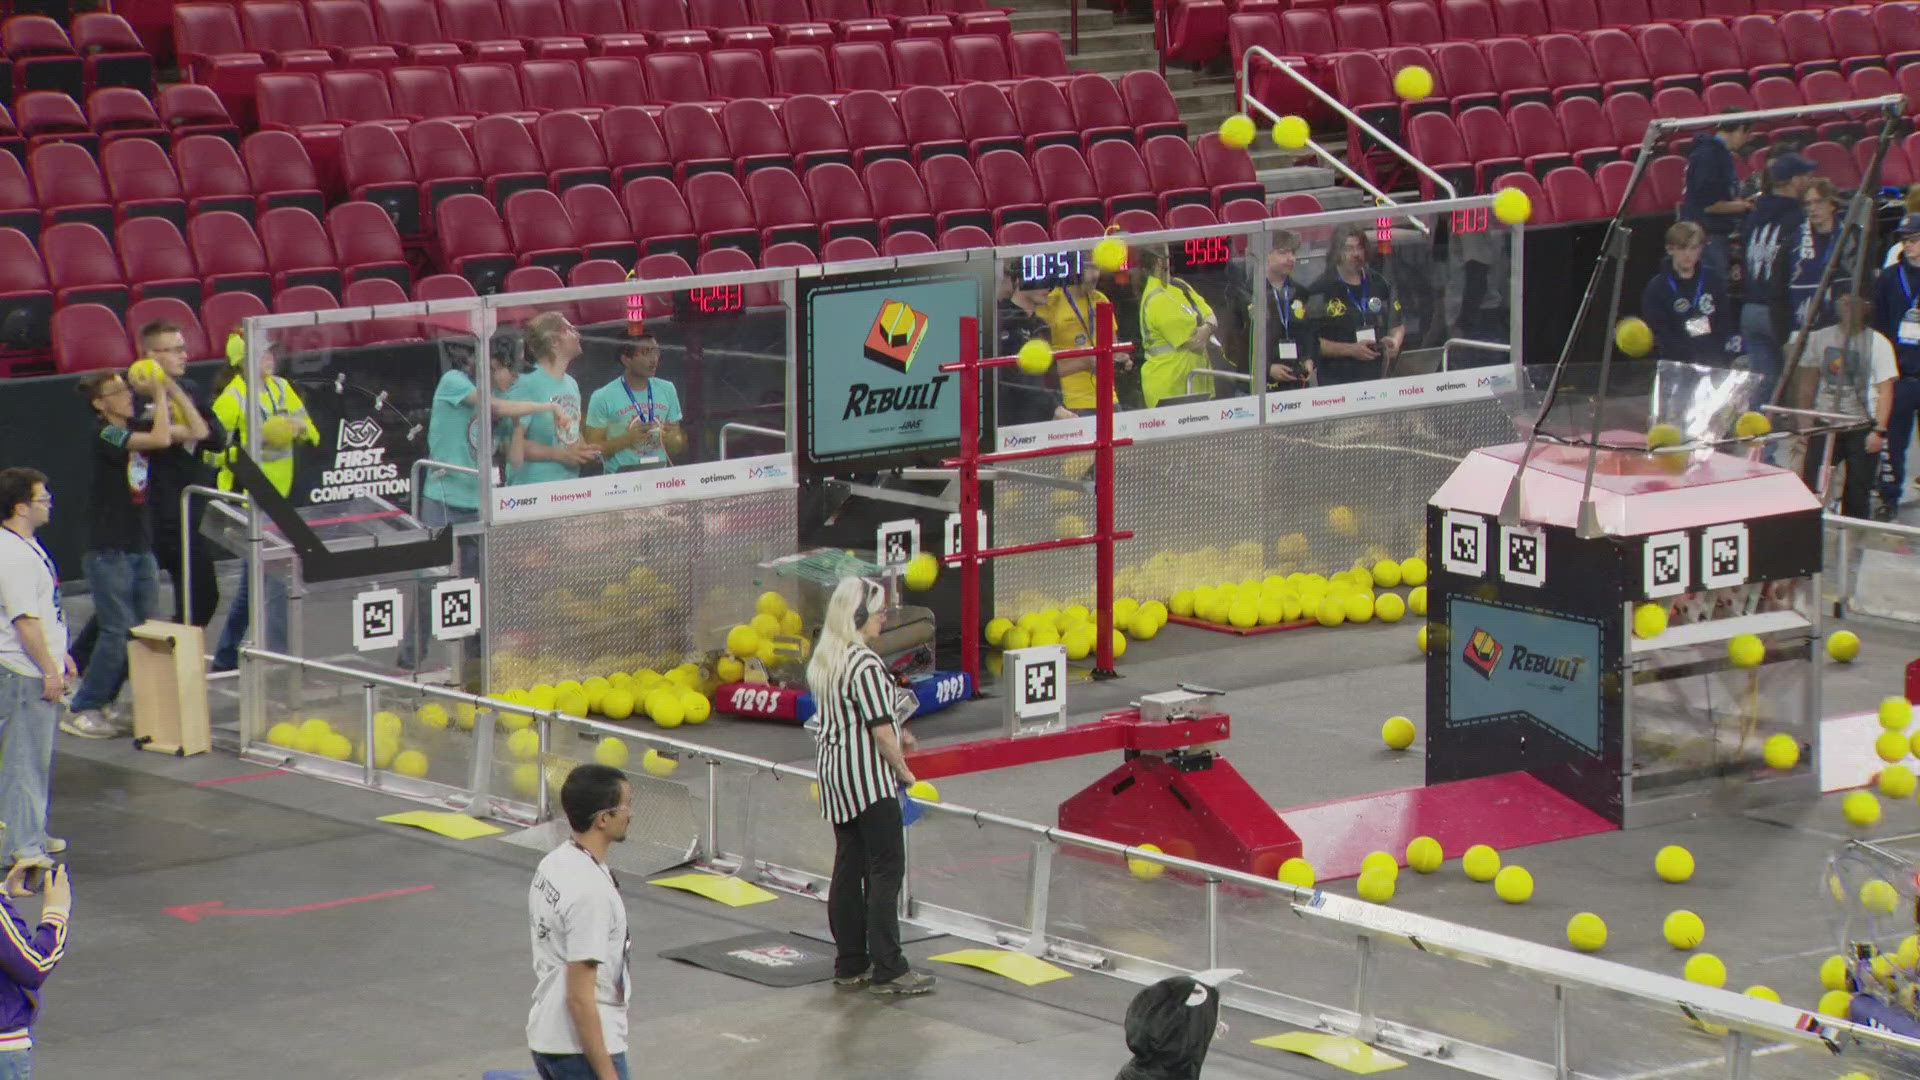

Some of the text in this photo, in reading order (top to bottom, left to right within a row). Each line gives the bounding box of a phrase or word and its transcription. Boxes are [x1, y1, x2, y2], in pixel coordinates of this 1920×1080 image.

[1451, 207, 1488, 234] 1303
[1184, 235, 1230, 265] 9585
[1022, 250, 1082, 281] 00:51
[690, 283, 742, 313] 4293
[842, 375, 950, 420] REBUILT
[1284, 402, 1301, 411] FIRST
[1312, 396, 1345, 407] Honeywell
[1398, 385, 1424, 396] molex
[1048, 429, 1083, 441] Honeywell
[1139, 419, 1166, 430] molex
[334, 448, 385, 468] FIRST
[322, 464, 397, 486] ROBOTICS
[310, 479, 410, 503] COMPETITION
[516, 497, 538, 507] FIRST
[550, 489, 592, 502] Honeywell
[656, 478, 686, 489] molex
[700, 473, 736, 485] optimum.
[1509, 644, 1586, 681] REBUILT
